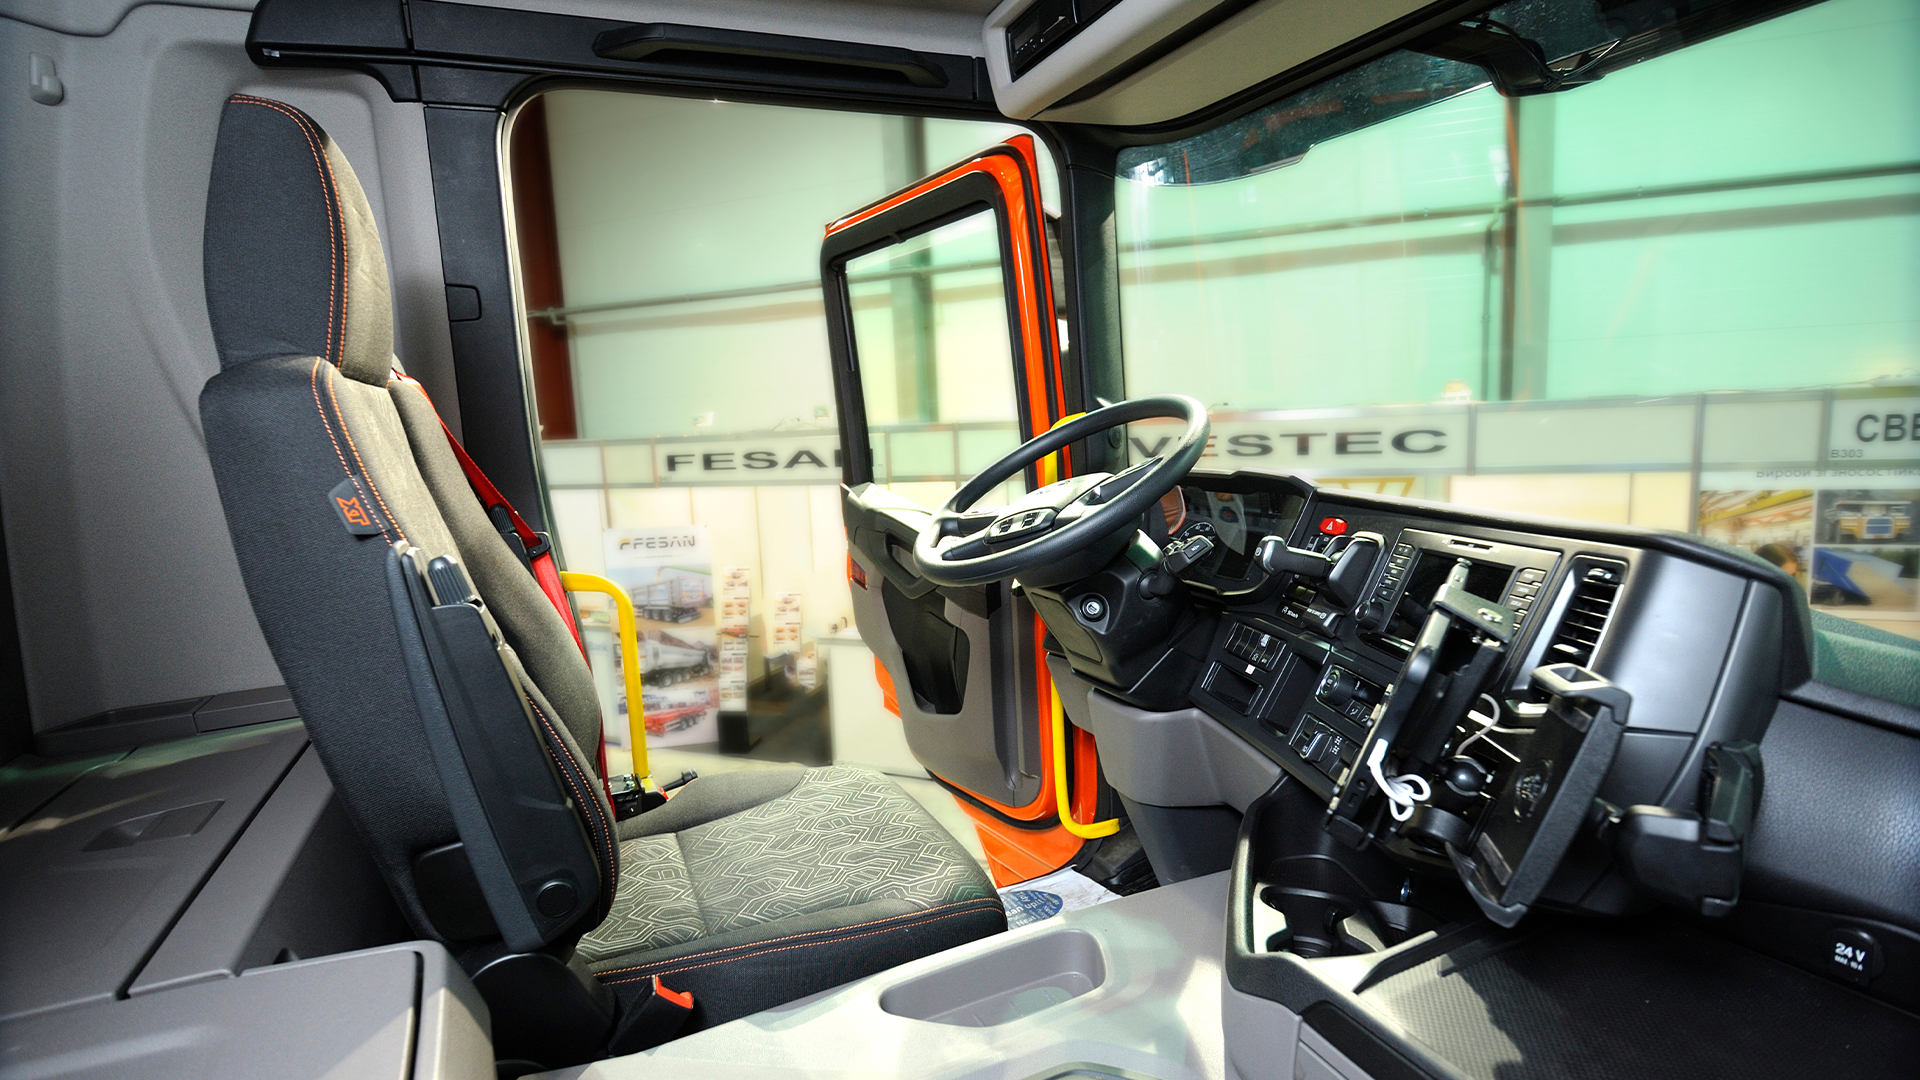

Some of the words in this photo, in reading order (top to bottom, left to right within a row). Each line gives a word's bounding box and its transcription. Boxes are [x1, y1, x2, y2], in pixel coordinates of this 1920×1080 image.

[1129, 429, 1447, 458] VSTEC
[1831, 449, 1864, 458] B303
[633, 535, 696, 550] FESAN
[1835, 942, 1854, 959] 24
[1855, 949, 1866, 962] V
